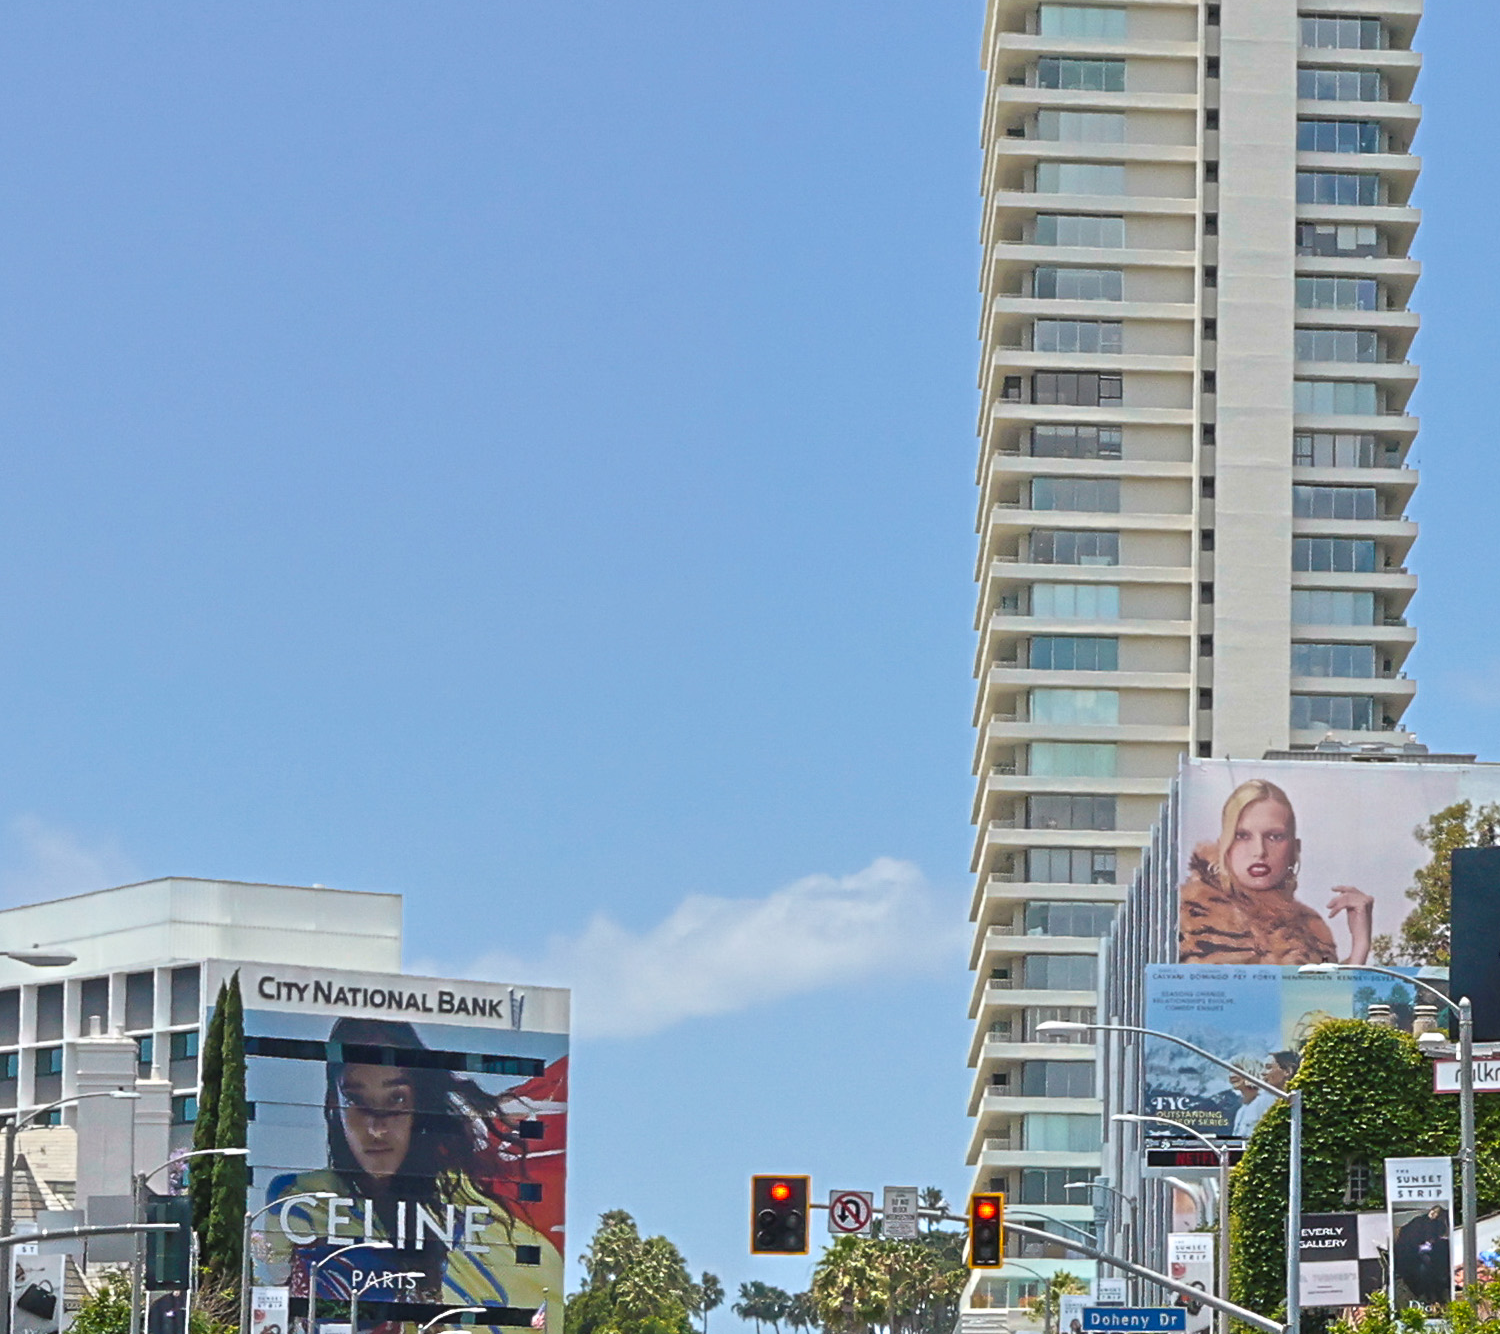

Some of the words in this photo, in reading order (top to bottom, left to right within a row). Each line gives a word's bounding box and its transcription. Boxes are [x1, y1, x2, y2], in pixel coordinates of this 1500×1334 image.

[258, 976, 311, 1003] CITY
[313, 980, 434, 1013] NATIONAL
[438, 991, 504, 1019] BANK
[1396, 1175, 1443, 1184] SUNSET
[1397, 1189, 1443, 1199] STRIP
[279, 1196, 491, 1254] CELINE
[352, 1269, 417, 1290] PARIS
[1090, 1313, 1151, 1329] Doheny
[1159, 1313, 1178, 1327] Dr
